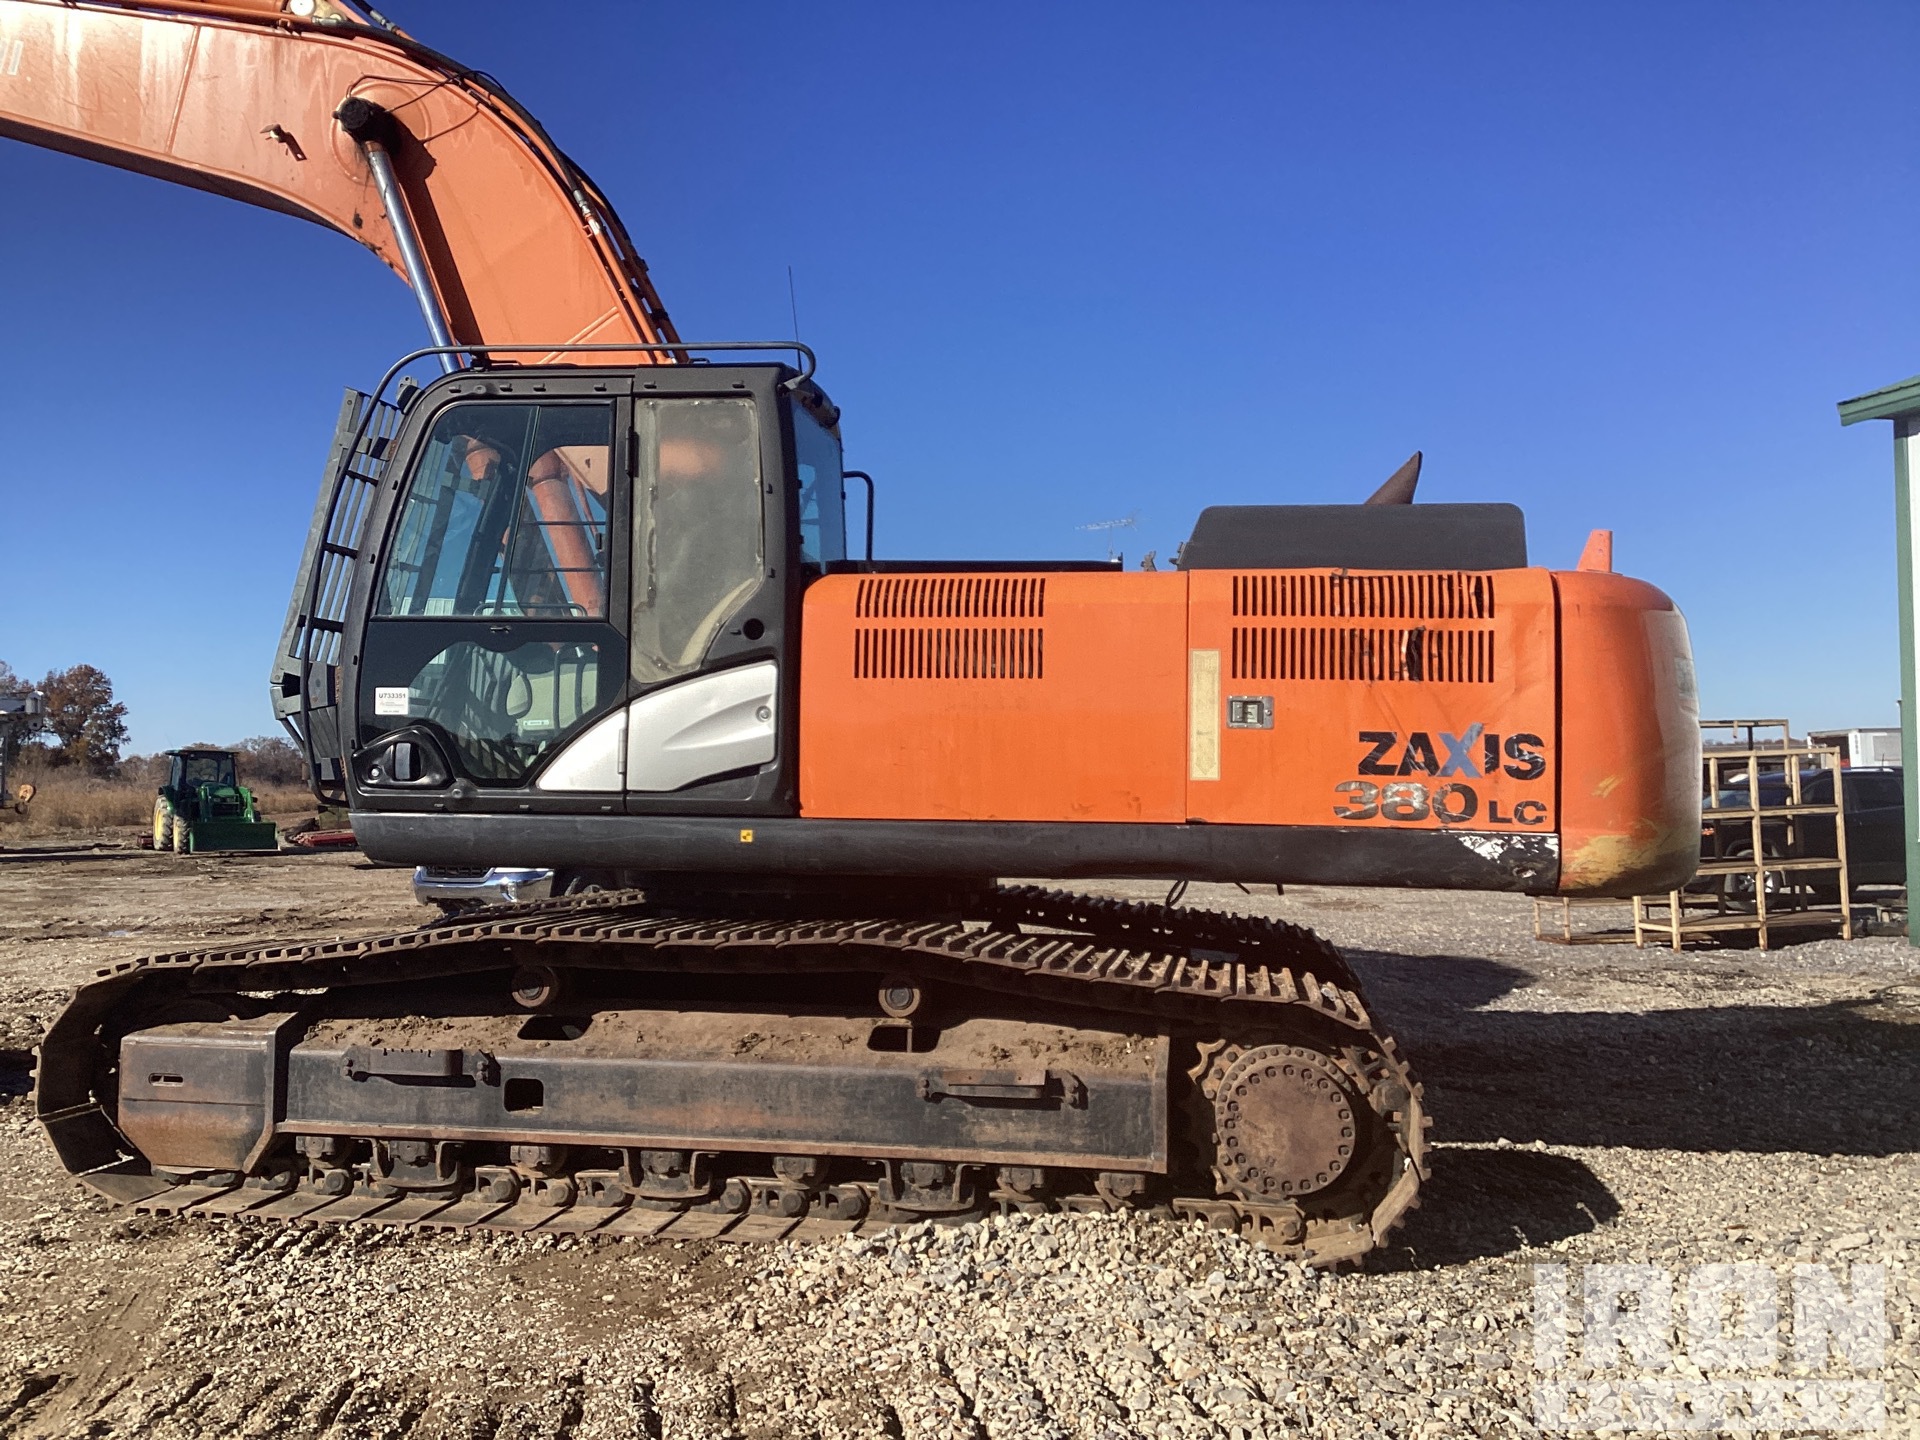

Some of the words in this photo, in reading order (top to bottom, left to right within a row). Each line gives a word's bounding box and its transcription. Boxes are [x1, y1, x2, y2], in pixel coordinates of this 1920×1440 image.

[1358, 722, 1546, 780] ZAXIS
[1333, 780, 1478, 824] 380
[1489, 800, 1548, 825] LC
